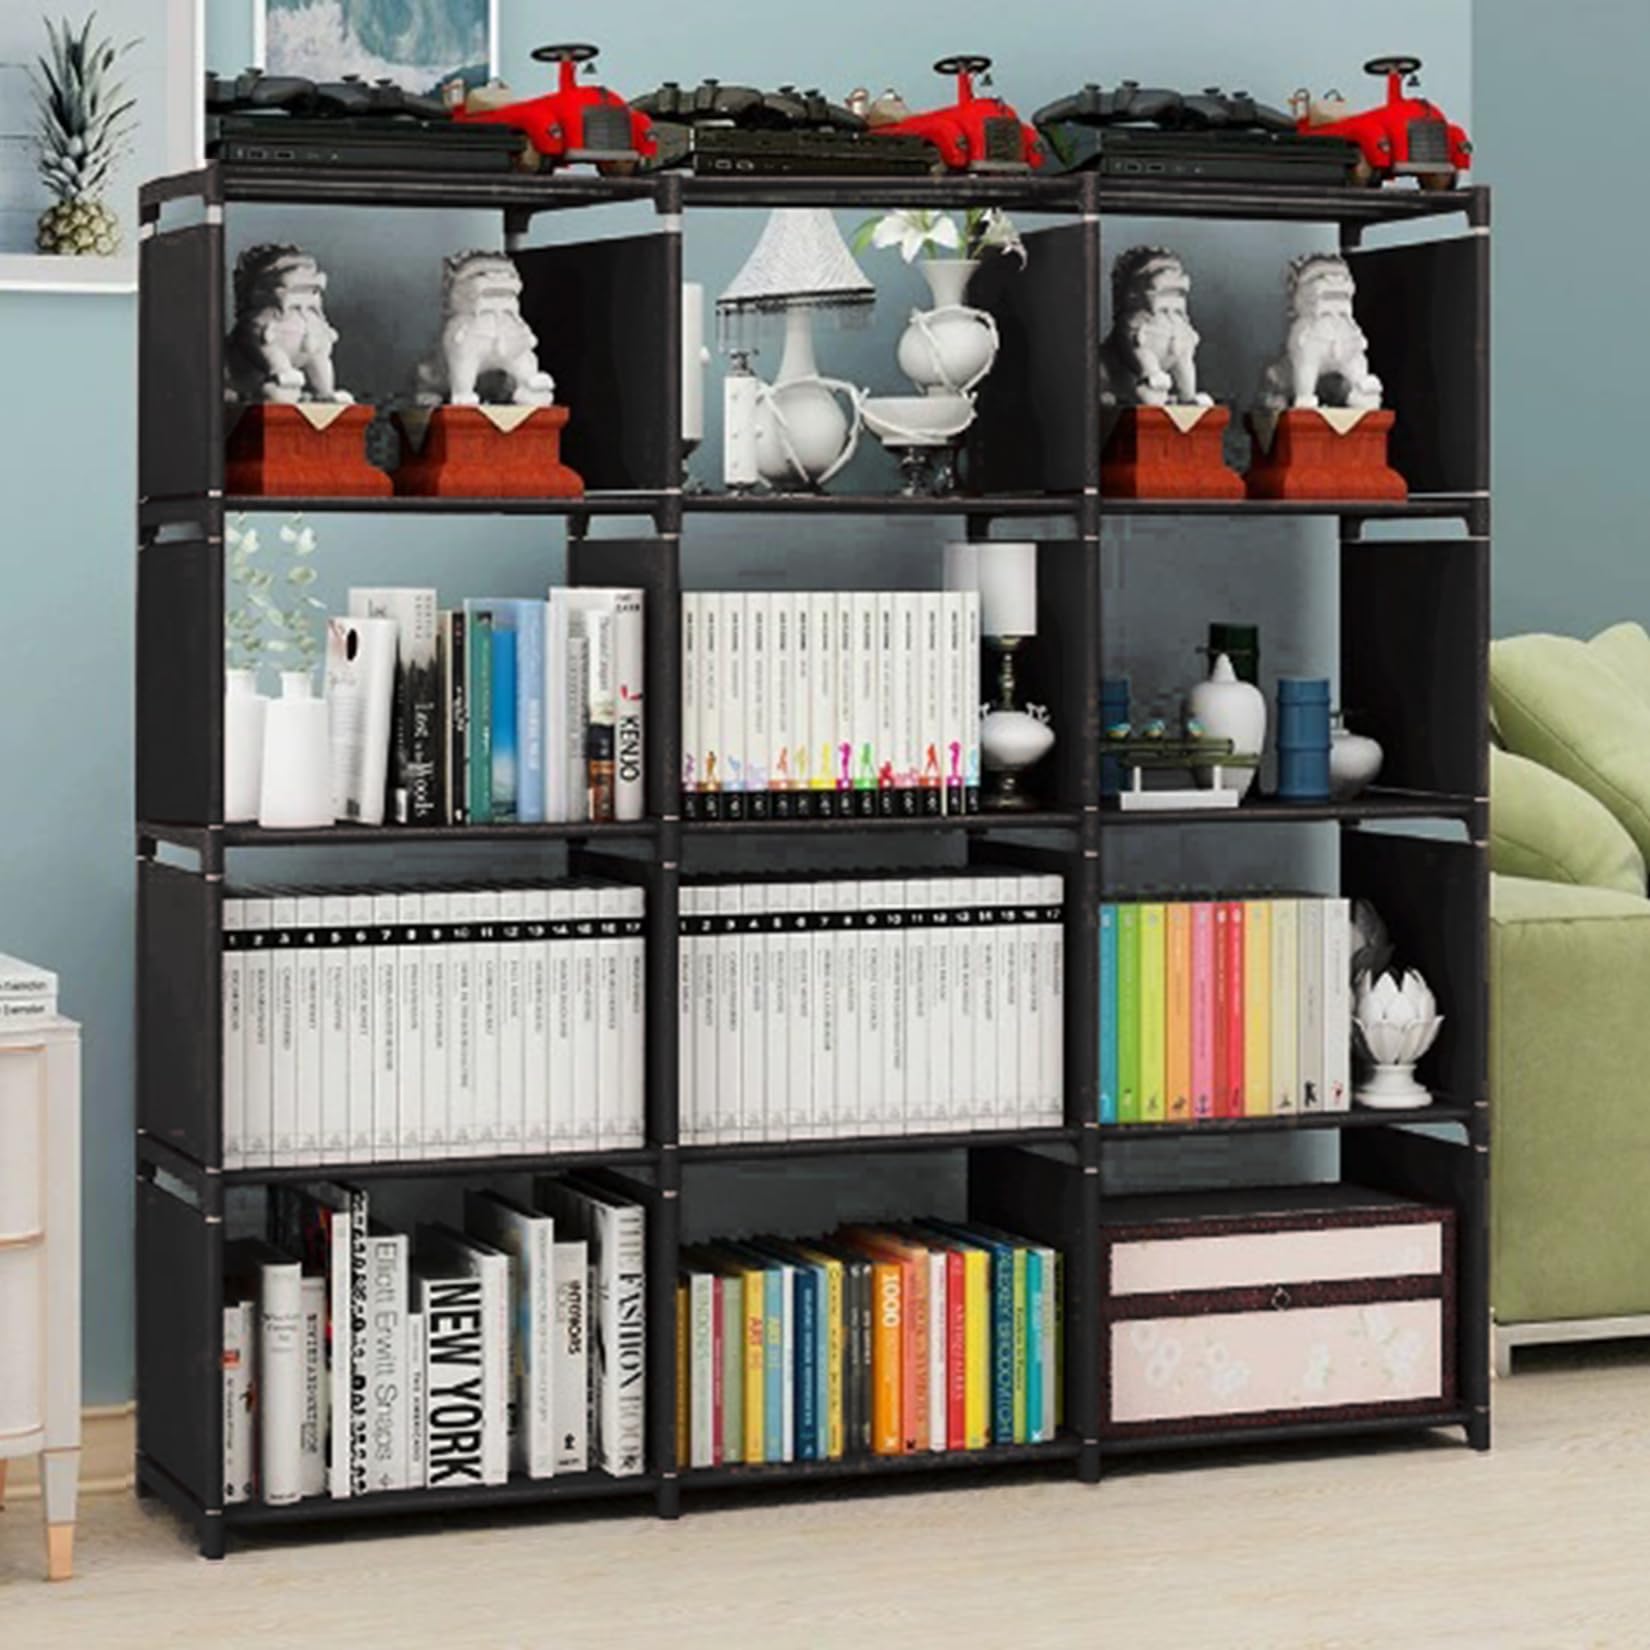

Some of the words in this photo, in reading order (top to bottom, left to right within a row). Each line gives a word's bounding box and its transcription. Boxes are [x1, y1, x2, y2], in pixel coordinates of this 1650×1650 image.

[430, 1283, 482, 1365] NEW
[619, 1273, 642, 1388] FASHION
[881, 1274, 901, 1329] 1000
[374, 1311, 398, 1376] Erwitt
[374, 1384, 398, 1461] Snaps
[430, 1378, 482, 1484] YORK
